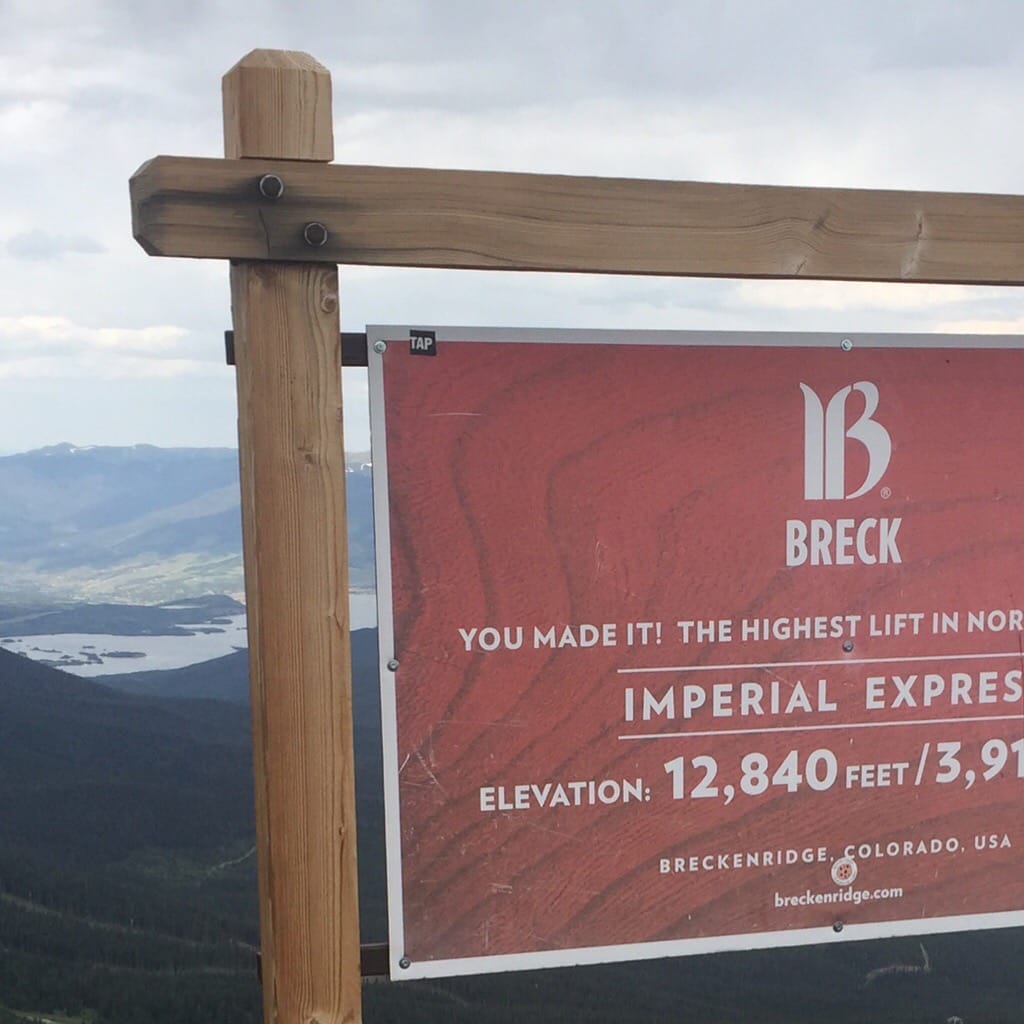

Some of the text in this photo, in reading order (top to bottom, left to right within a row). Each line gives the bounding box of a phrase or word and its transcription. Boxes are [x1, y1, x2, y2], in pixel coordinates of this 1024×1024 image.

[409, 336, 432, 350] TAP
[786, 517, 902, 567] BRECK
[458, 626, 523, 651] YOU
[533, 623, 617, 649] MADE
[627, 621, 662, 646] IT!
[677, 619, 732, 644] THE
[741, 615, 862, 641] HIGHEST
[869, 612, 925, 637] LIFT
[932, 611, 959, 634] IN
[625, 679, 837, 721] IMPERIAL
[479, 778, 651, 812] ELEVATION:
[663, 748, 838, 806] 12,840
[845, 762, 910, 789] FEET
[659, 847, 834, 875] BRECKENRIDGE,
[844, 837, 965, 861] COLORADO,
[974, 834, 1012, 850] USA
[774, 885, 903, 908] breckenridge.com
